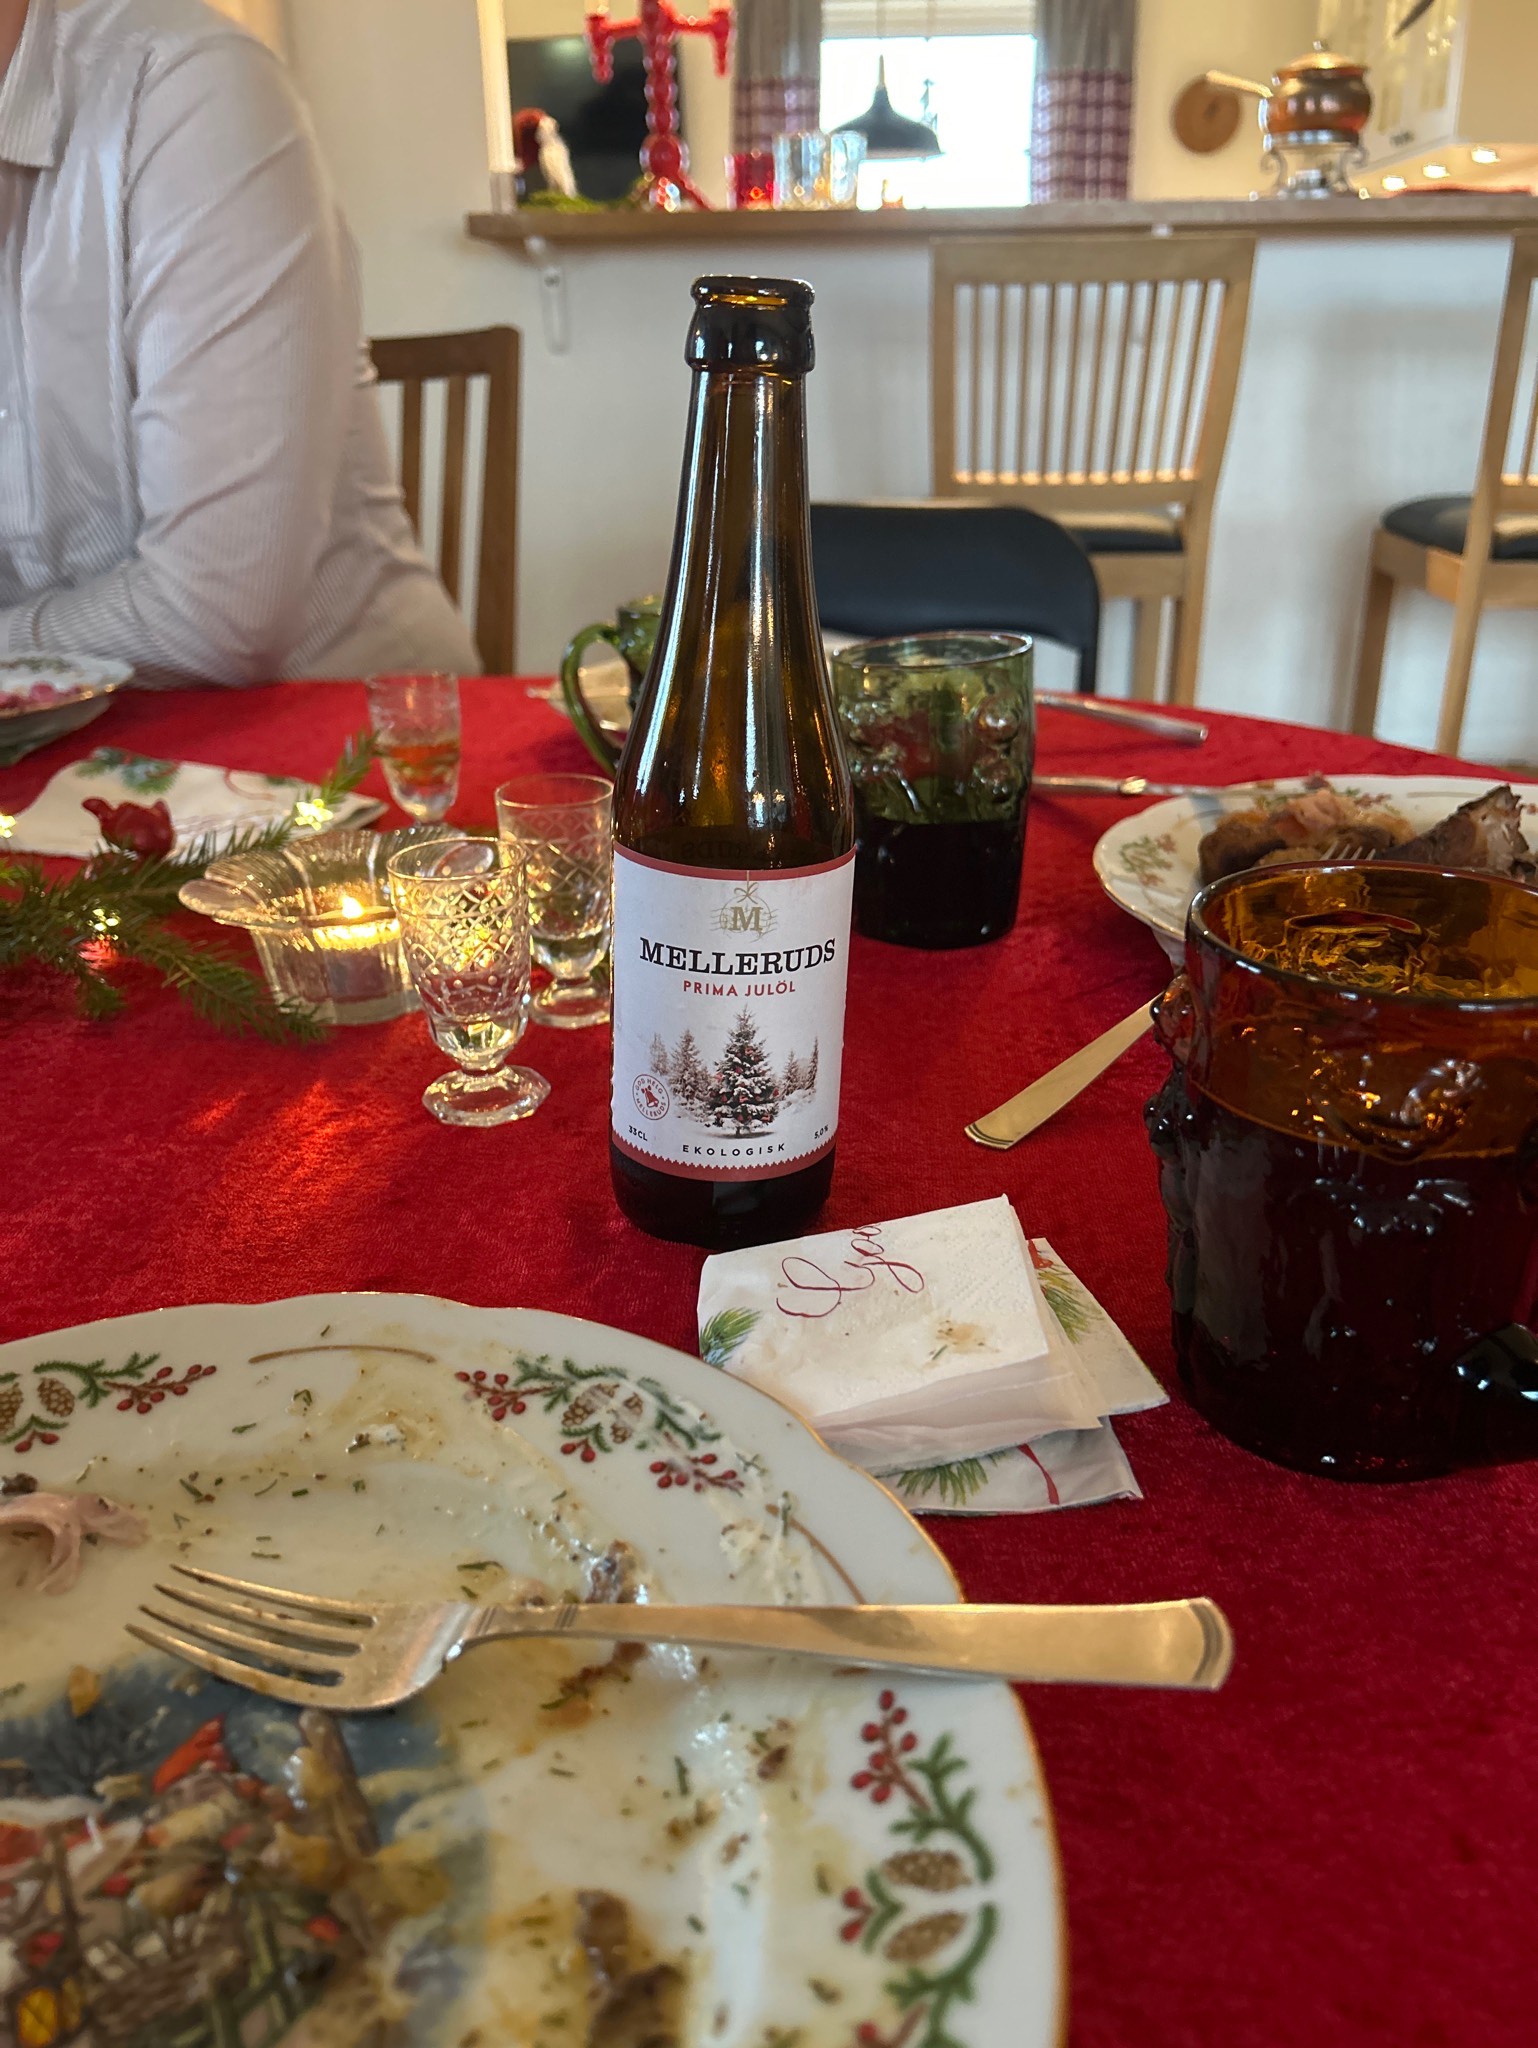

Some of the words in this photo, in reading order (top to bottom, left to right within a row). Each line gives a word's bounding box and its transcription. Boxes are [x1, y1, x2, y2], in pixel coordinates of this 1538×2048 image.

[728, 906, 764, 931] M
[639, 937, 836, 976] MELLERUDS
[683, 980, 738, 997] PRIMA
[744, 980, 796, 997] JULÖL
[628, 1125, 648, 1142] 33CL
[682, 1143, 785, 1157] EKOLOGISK
